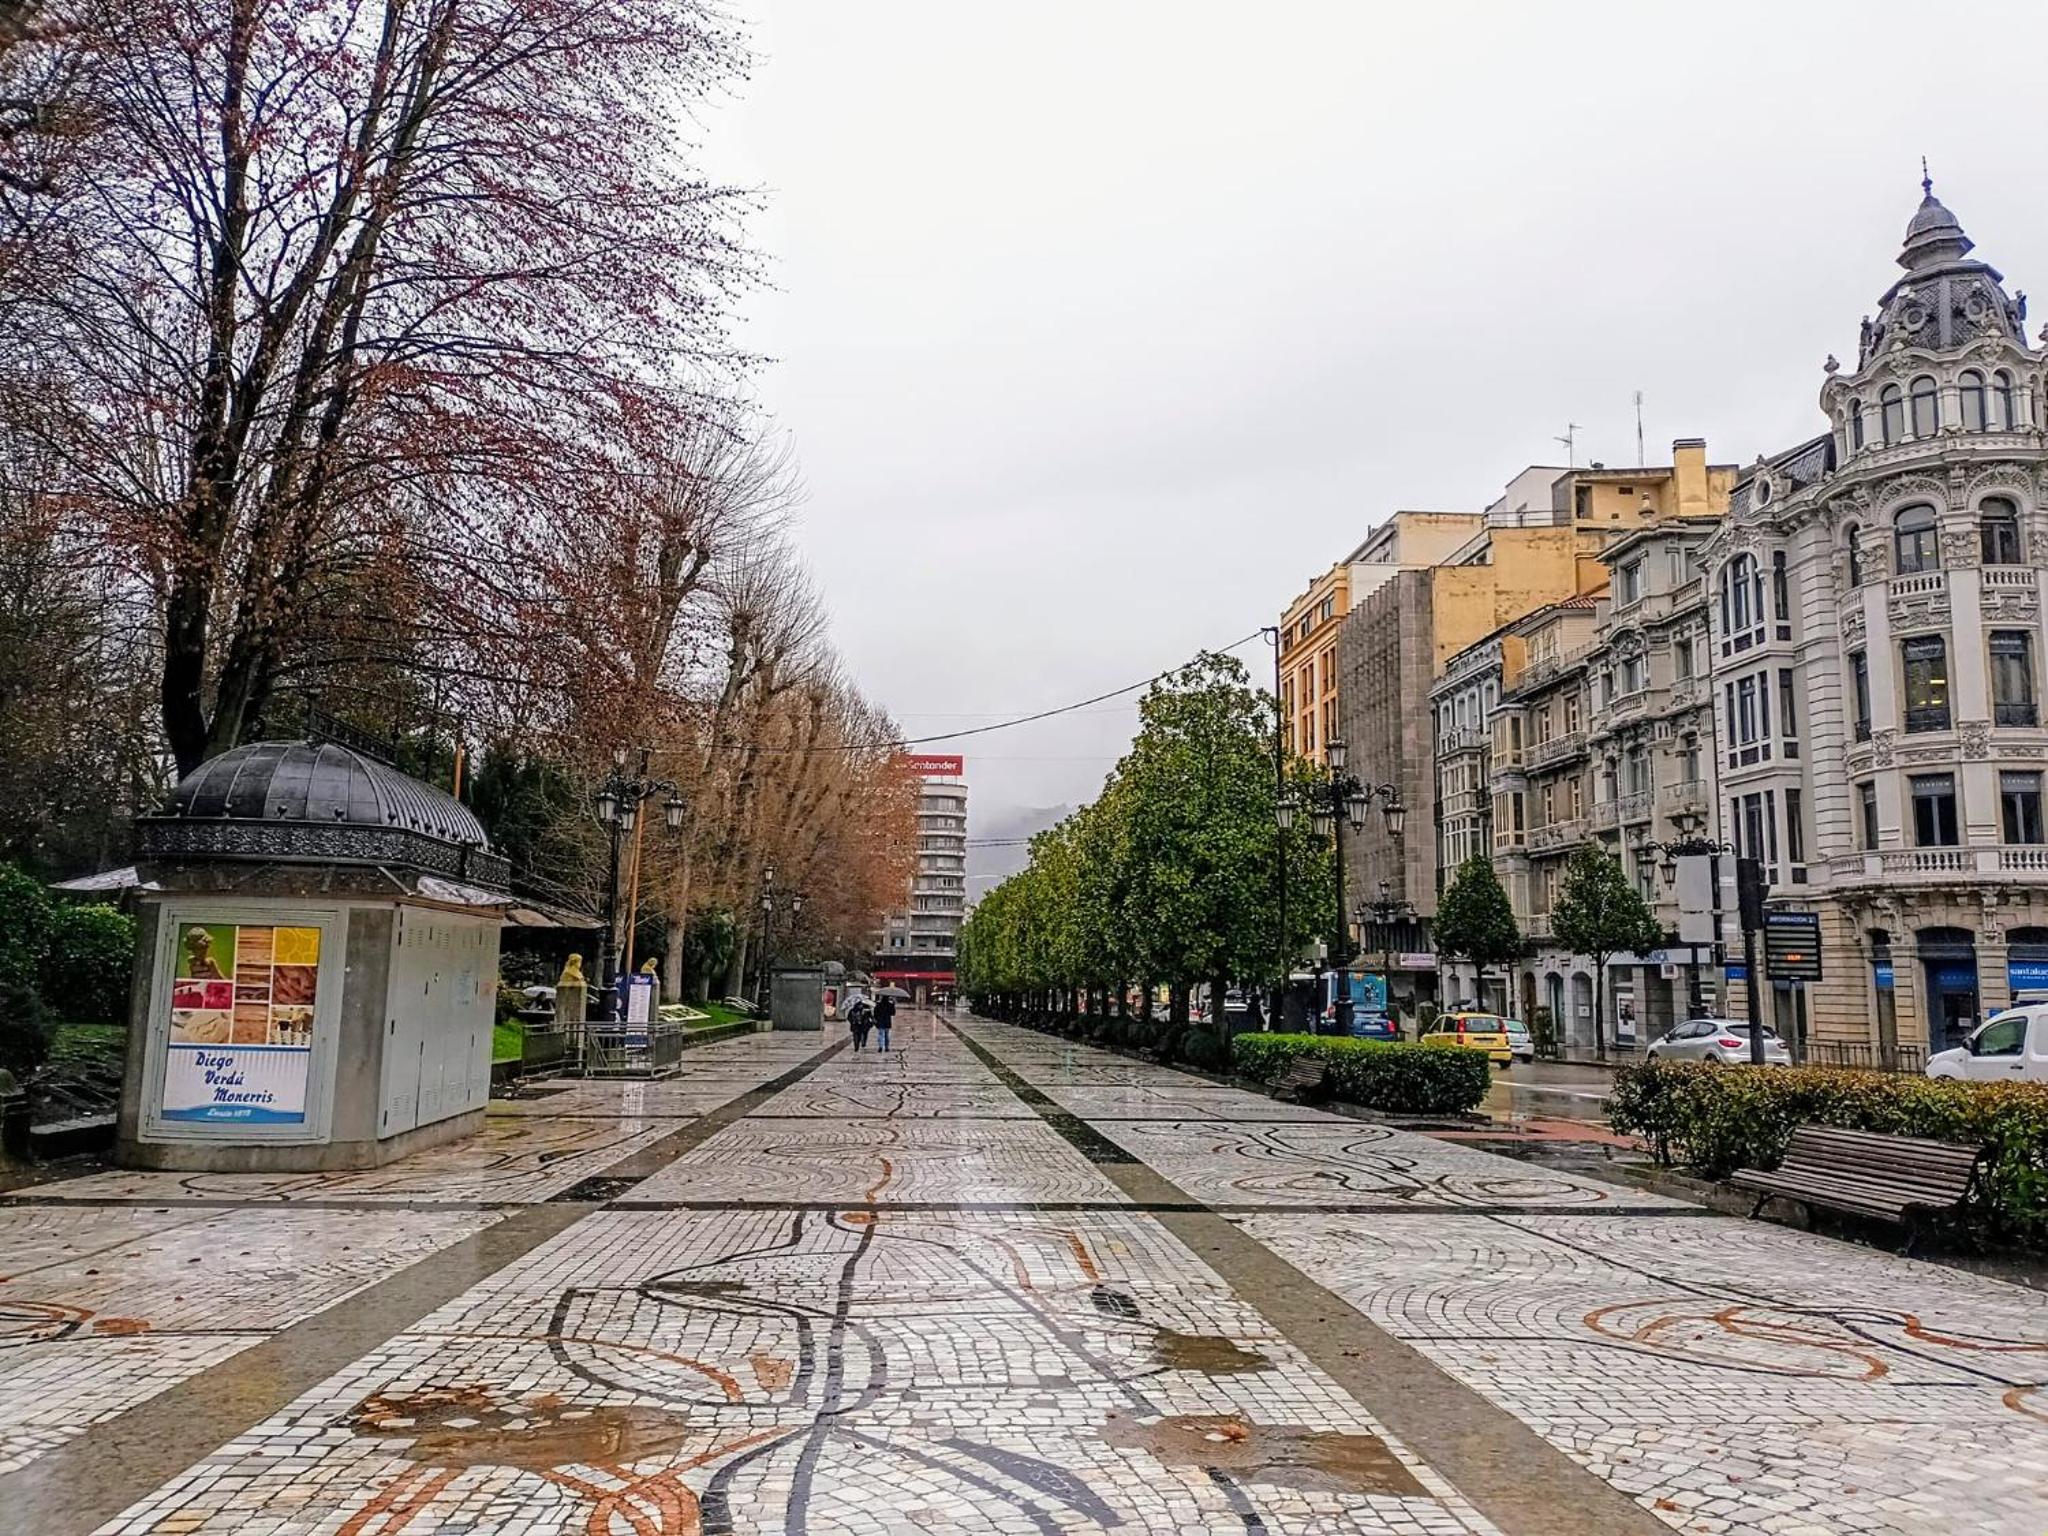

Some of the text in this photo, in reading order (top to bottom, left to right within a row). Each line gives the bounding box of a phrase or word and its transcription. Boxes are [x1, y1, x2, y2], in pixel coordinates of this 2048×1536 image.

[910, 760, 958, 770] Santander
[195, 1052, 233, 1070] Diego
[204, 1070, 244, 1086] Verdú
[213, 1086, 274, 1103] Monerris
